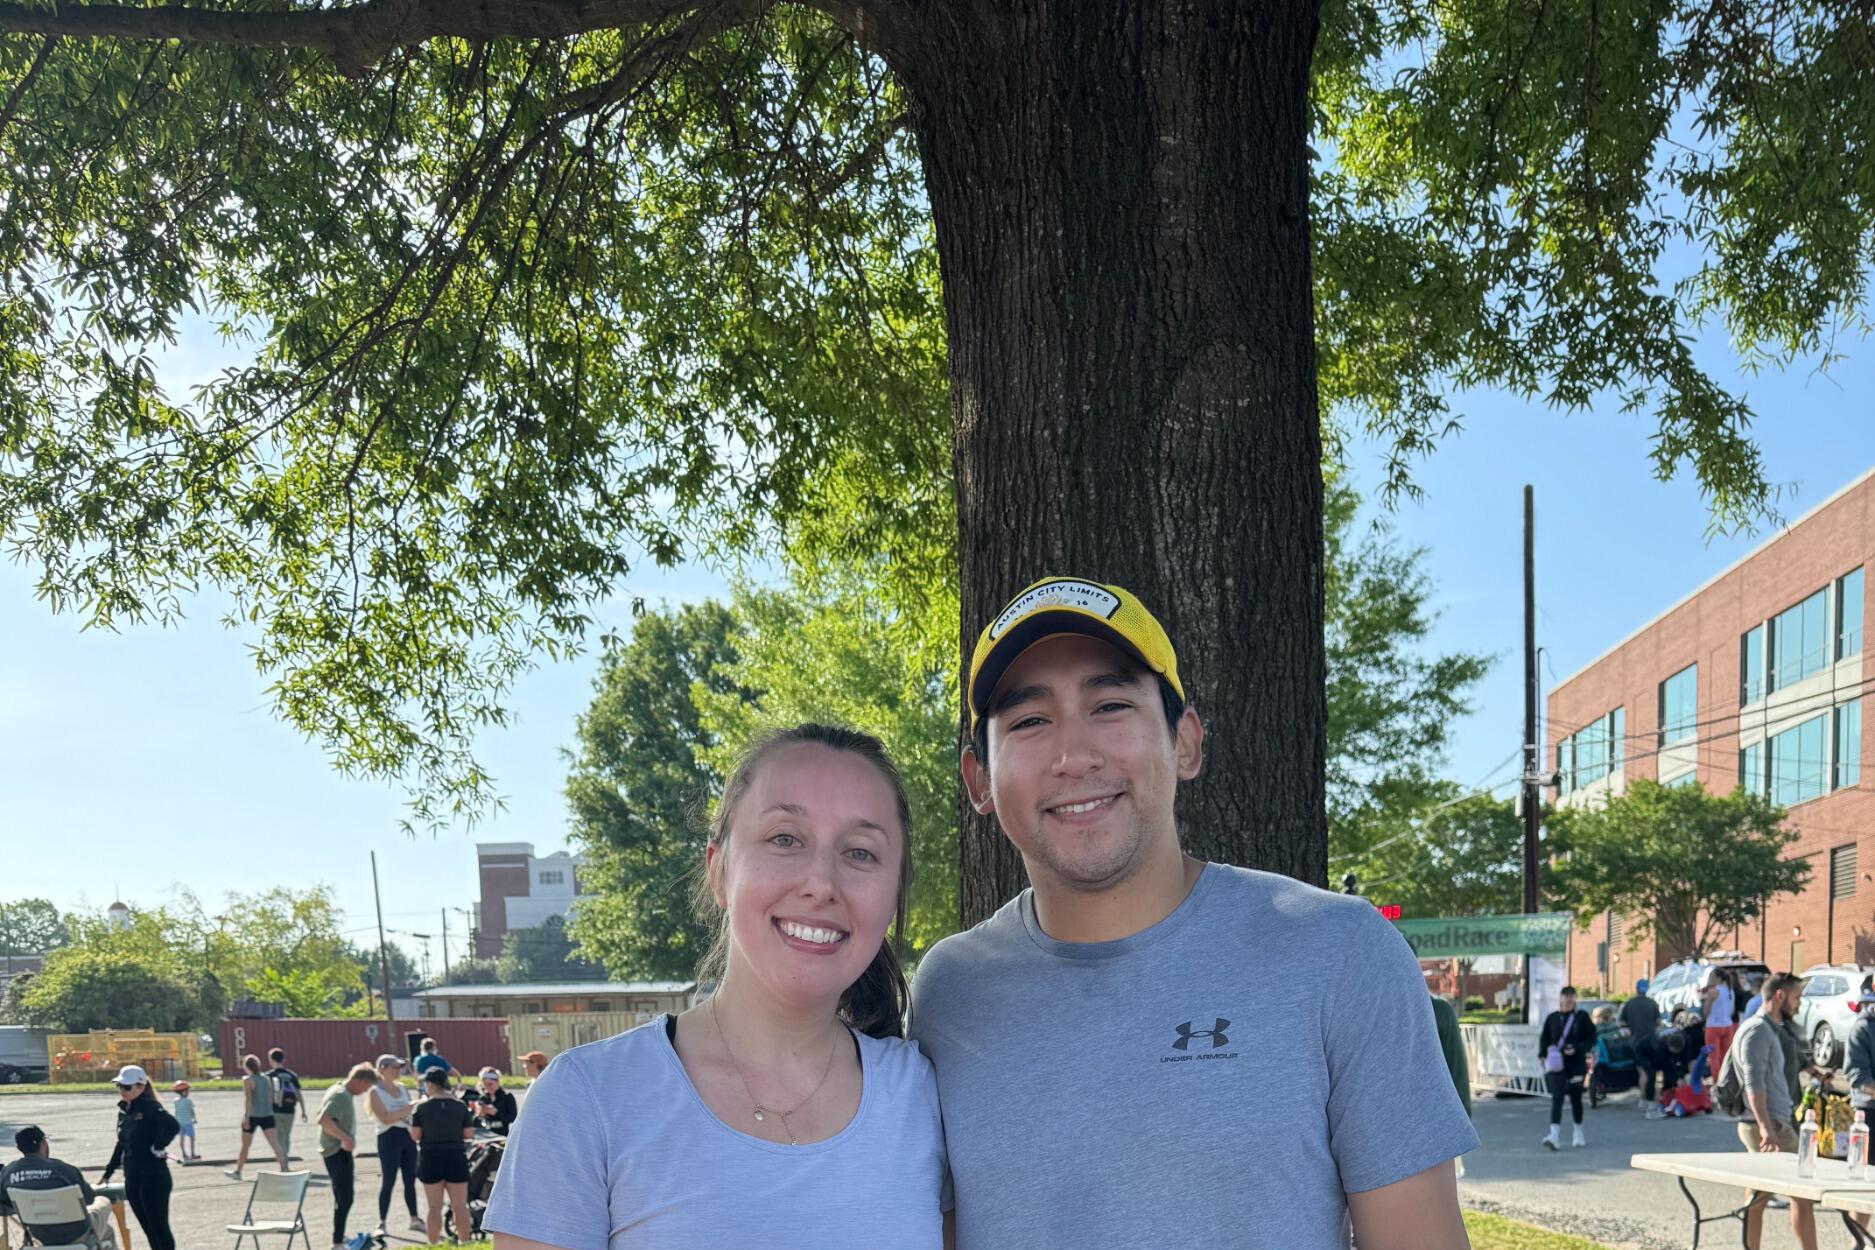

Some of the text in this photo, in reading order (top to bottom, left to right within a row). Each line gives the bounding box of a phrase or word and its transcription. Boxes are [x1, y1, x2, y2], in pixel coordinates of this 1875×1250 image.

[997, 594, 1034, 630] AUSTIN
[1038, 585, 1066, 597] CITY
[1069, 586, 1110, 602] LIMITS
[1401, 925, 1511, 950] oadRace
[1160, 1052, 1239, 1063] UNDER ARMOUR
